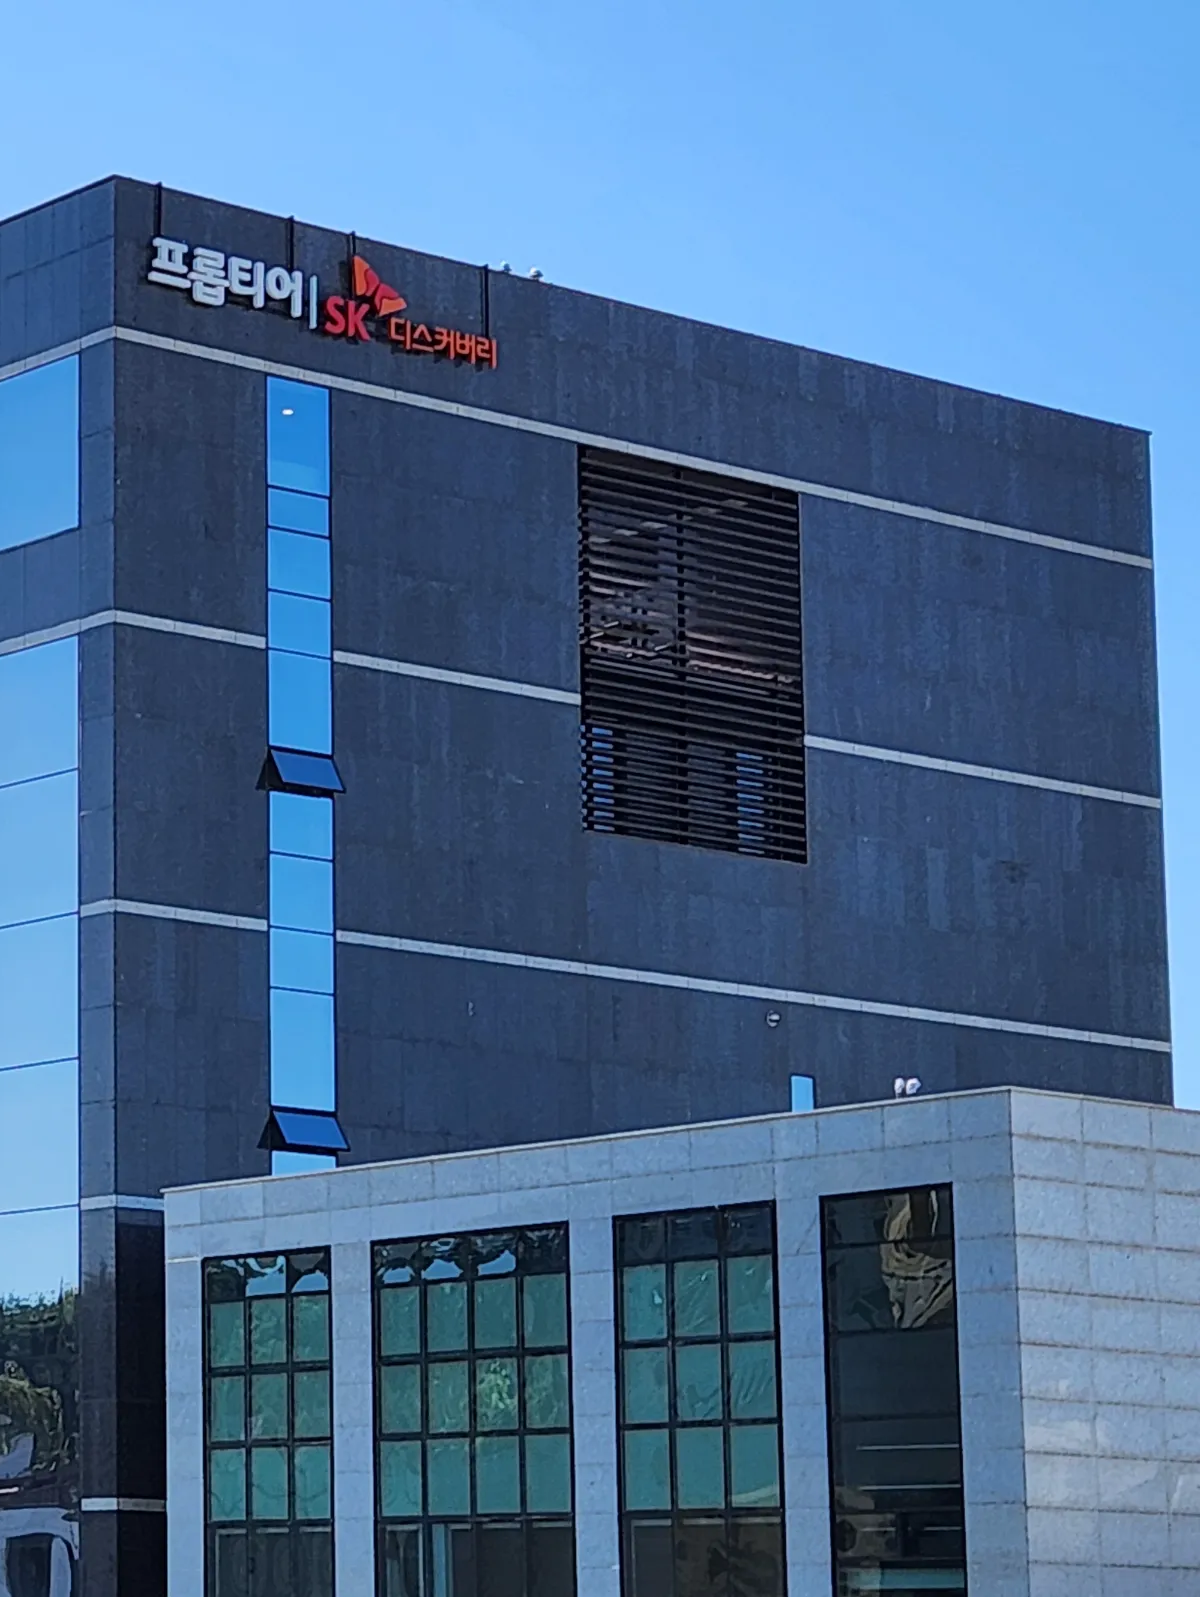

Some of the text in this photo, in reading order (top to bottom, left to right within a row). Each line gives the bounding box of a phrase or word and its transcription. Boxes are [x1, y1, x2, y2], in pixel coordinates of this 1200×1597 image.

[147, 237, 302, 318] 프롭티어
[324, 296, 370, 341] SK
[389, 318, 497, 368] 디스커버리
